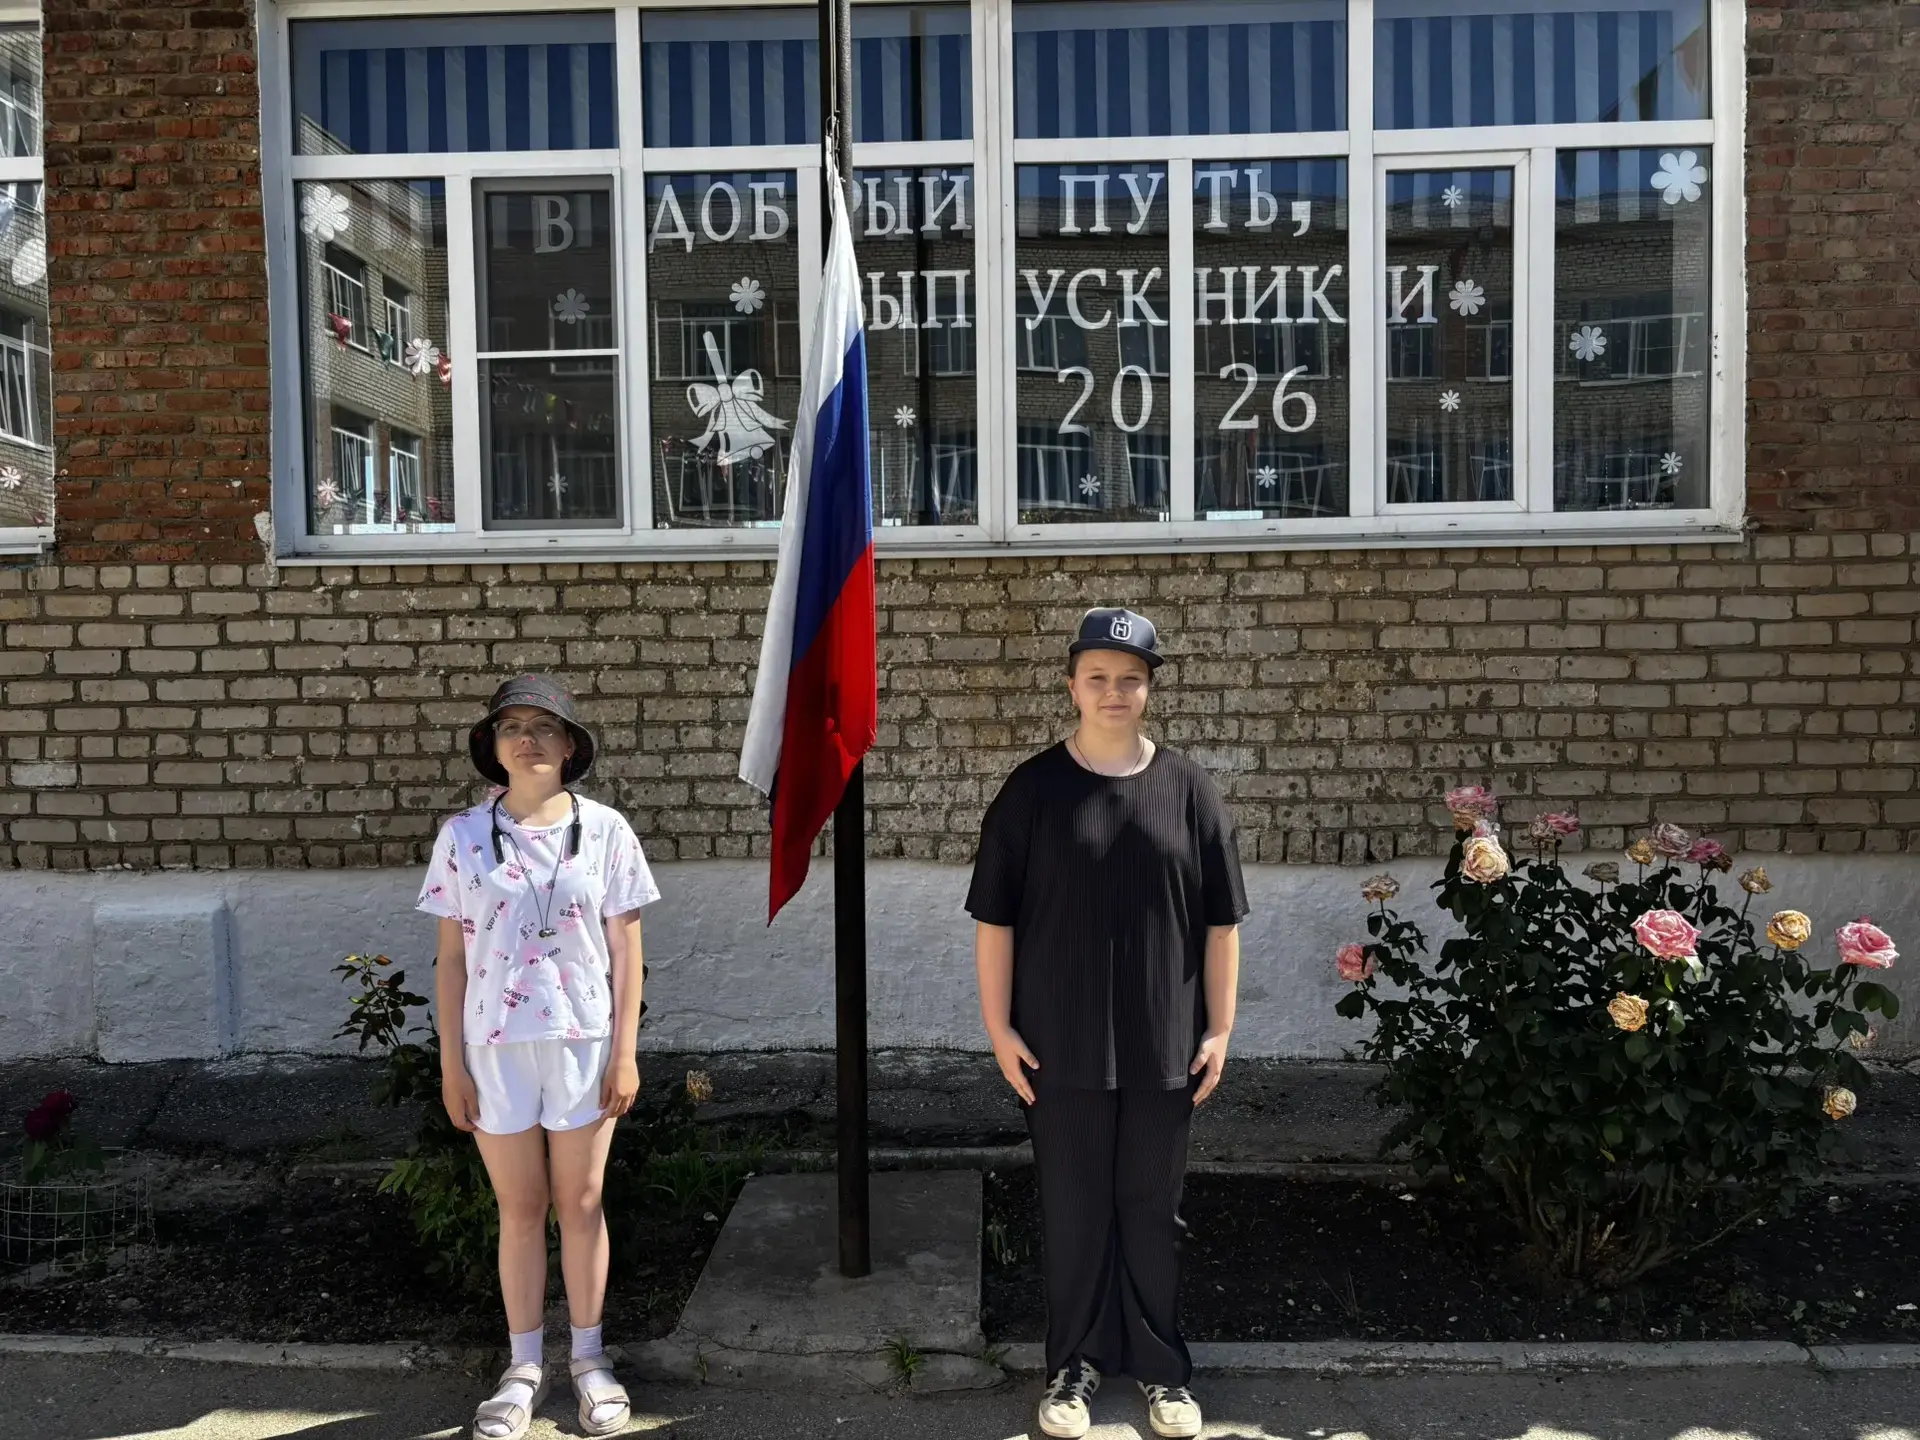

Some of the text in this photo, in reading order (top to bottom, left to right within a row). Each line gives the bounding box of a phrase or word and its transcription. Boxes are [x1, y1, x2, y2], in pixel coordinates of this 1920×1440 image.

[532, 195, 574, 253] В
[1058, 168, 1312, 237] ПУТЬ,
[859, 264, 1439, 331] ЫПУСКНИКИ
[1057, 362, 1317, 436] 2026
